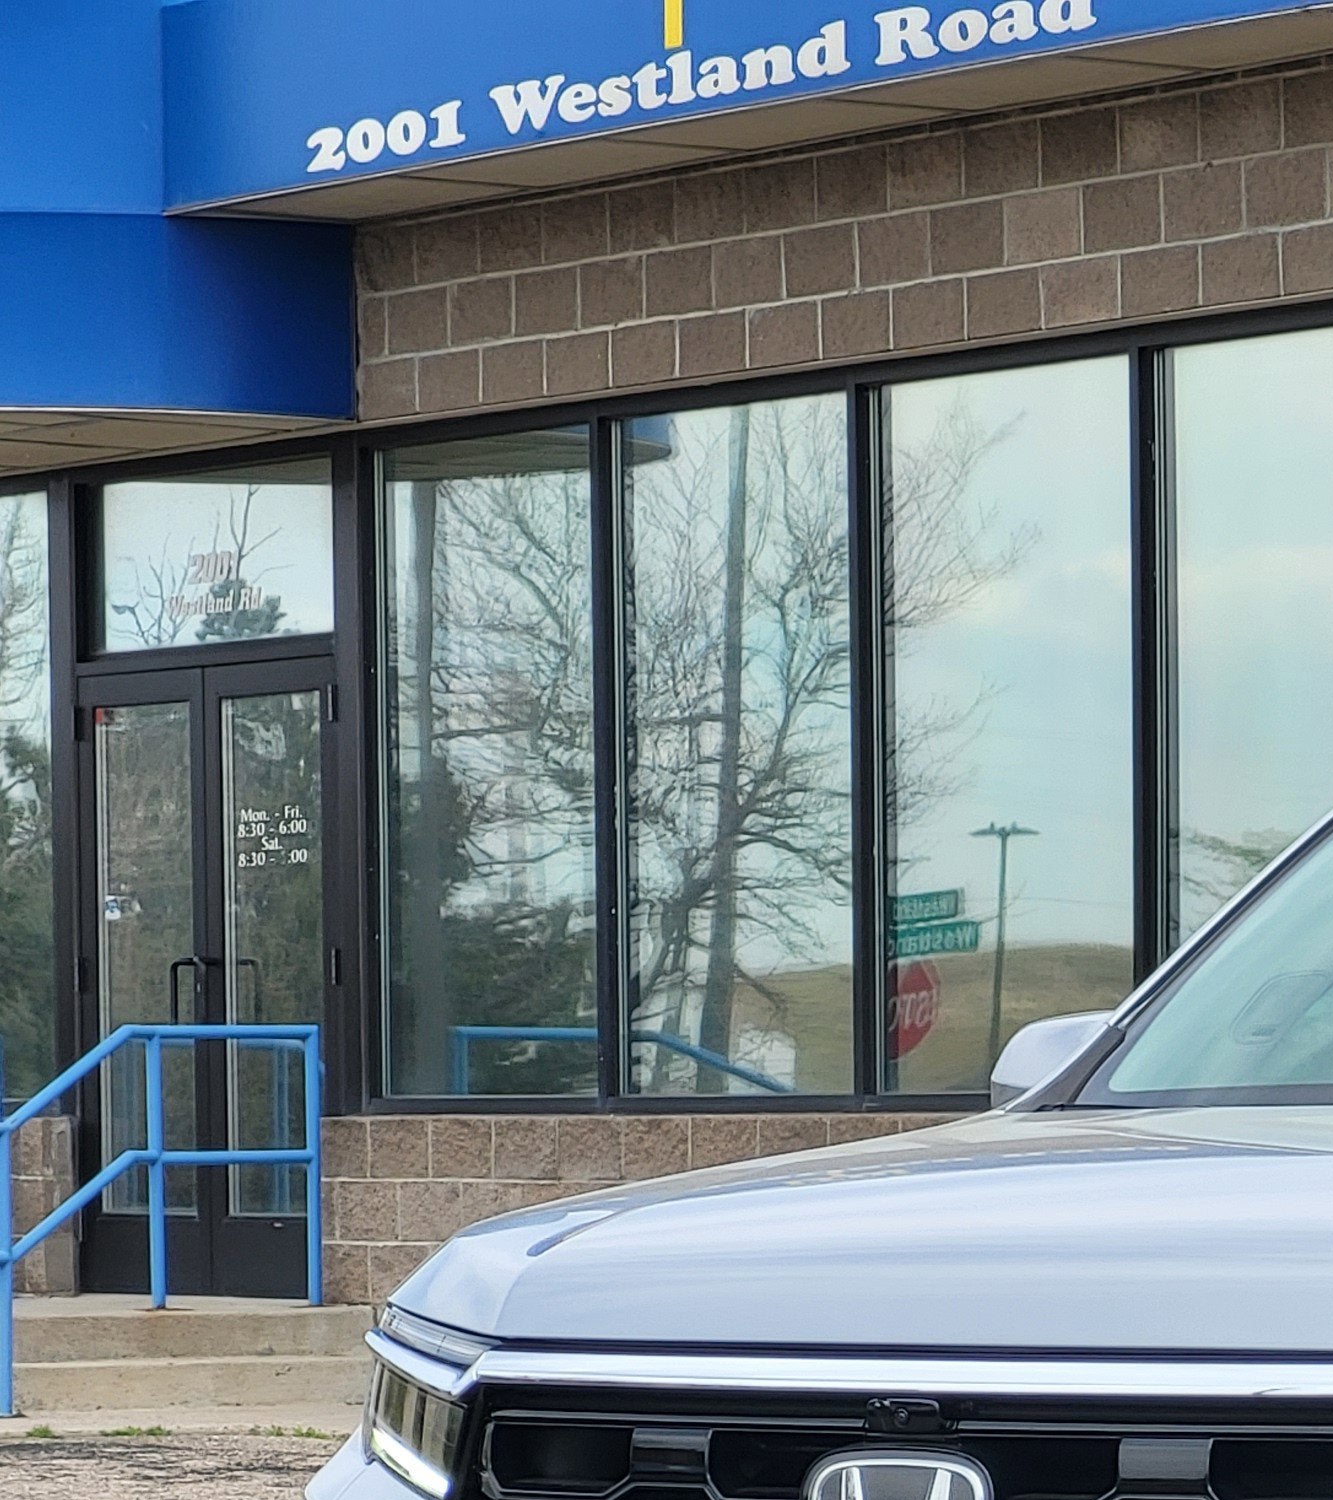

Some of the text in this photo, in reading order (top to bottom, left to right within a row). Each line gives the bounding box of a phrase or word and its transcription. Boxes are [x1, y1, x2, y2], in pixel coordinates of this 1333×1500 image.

[306, 0, 1098, 173] 2001 Westland Road
[240, 808, 270, 823] Mon.
[284, 805, 303, 819] Fri.
[238, 822, 265, 838] 8:30
[279, 819, 307, 834] 6:00
[238, 852, 266, 868] 8:30
